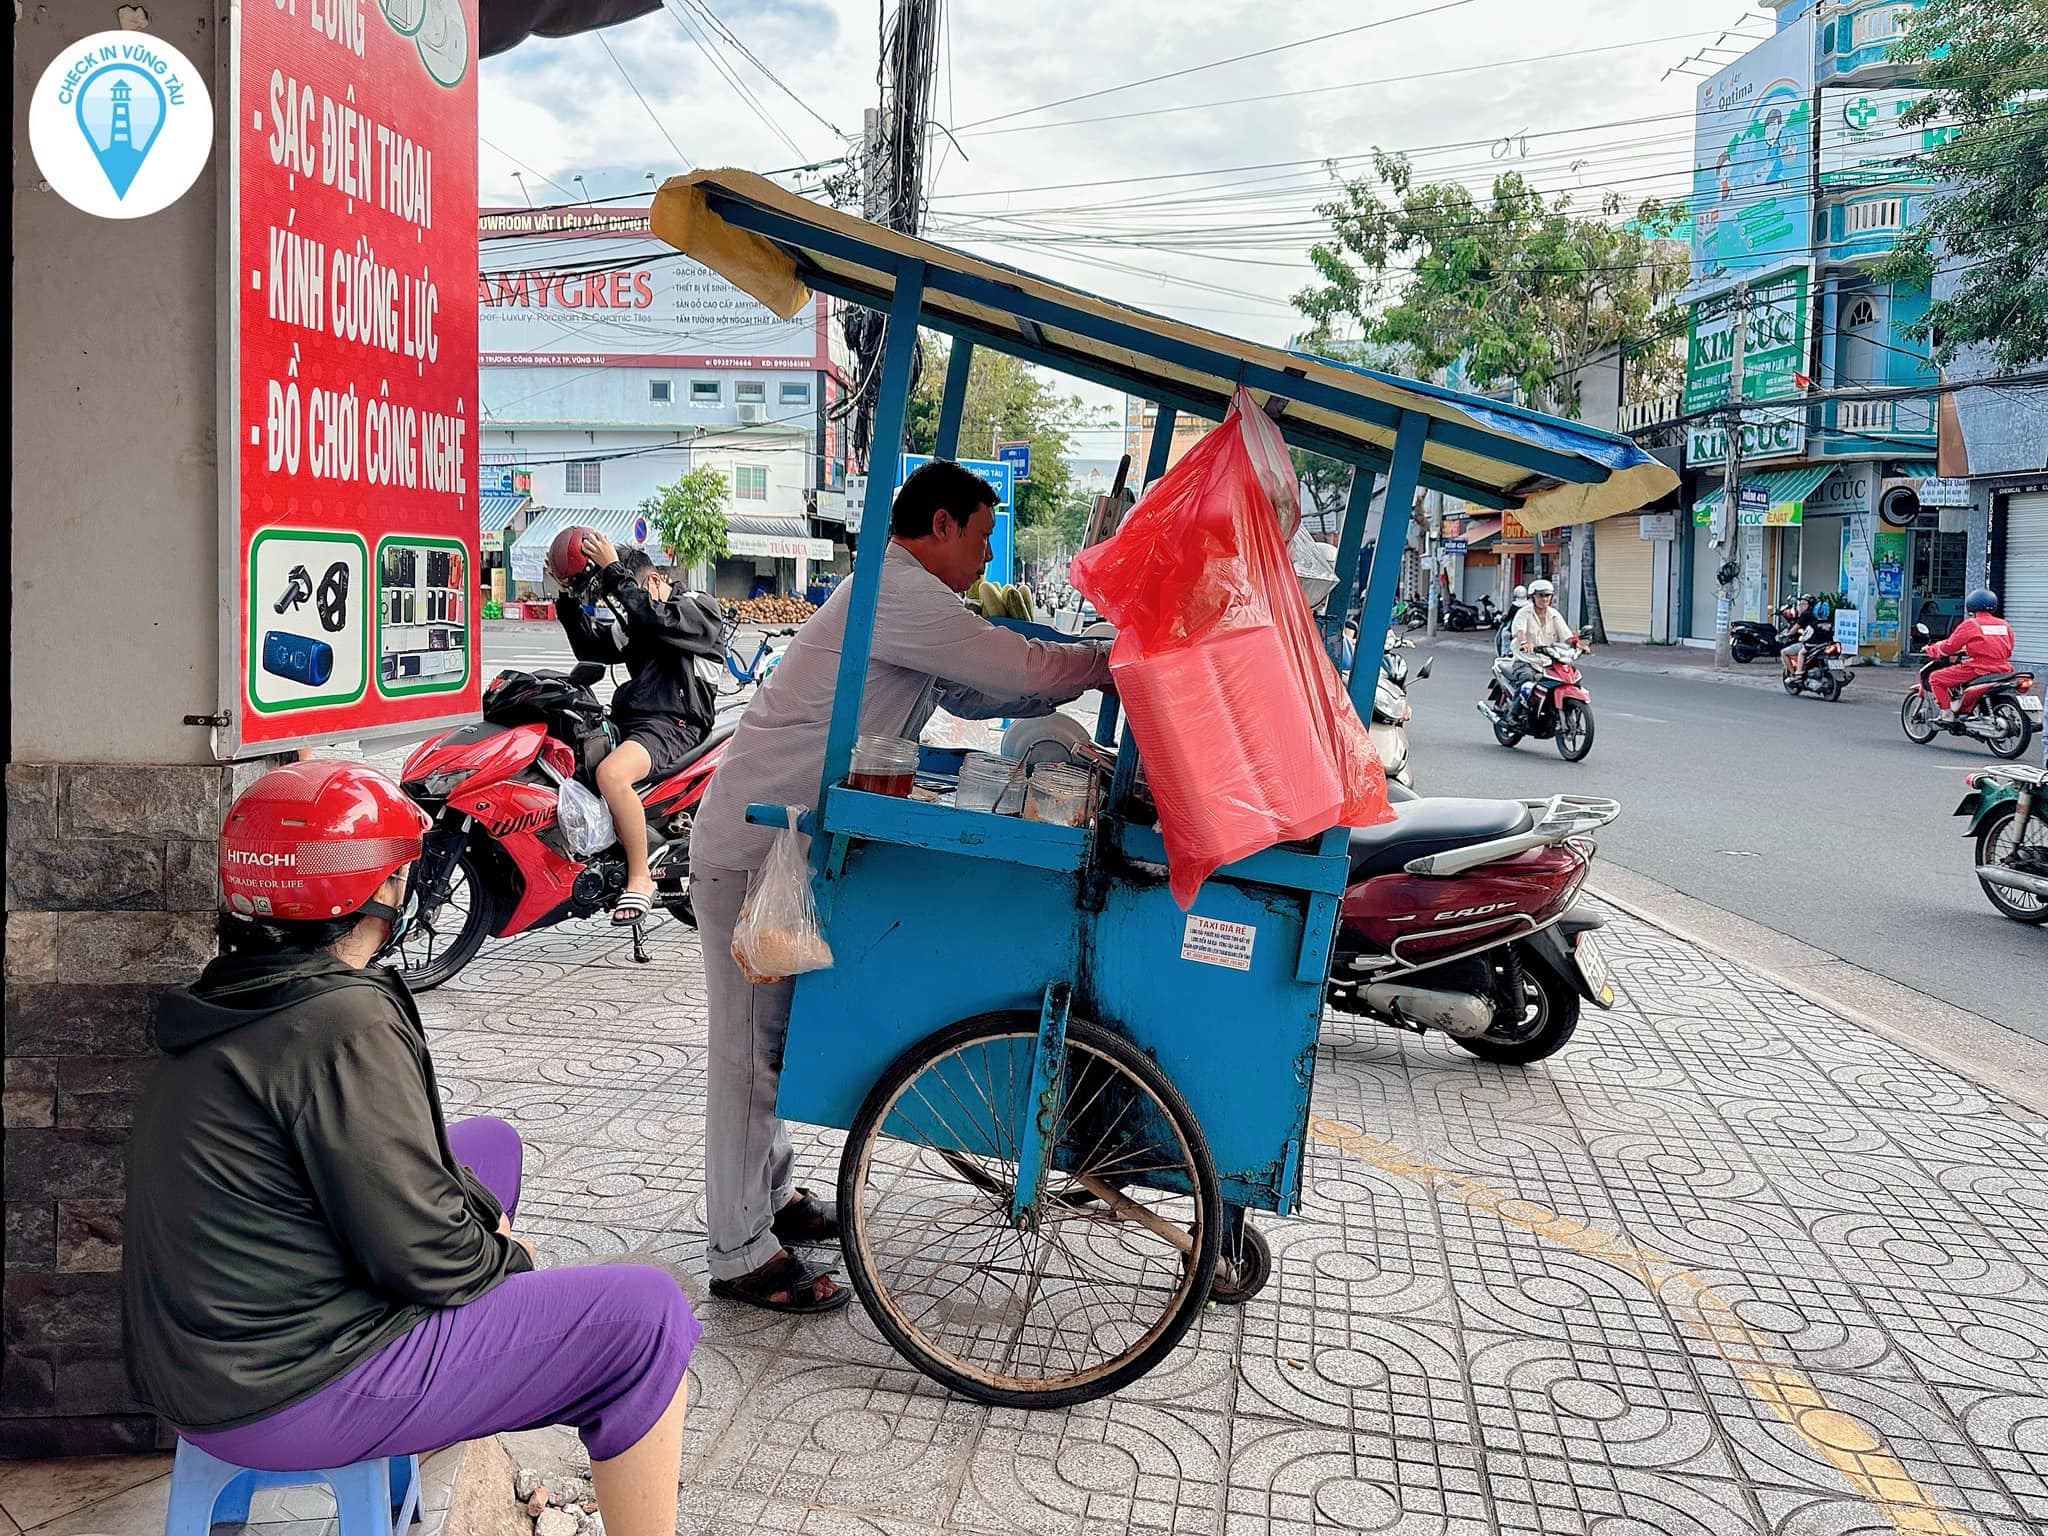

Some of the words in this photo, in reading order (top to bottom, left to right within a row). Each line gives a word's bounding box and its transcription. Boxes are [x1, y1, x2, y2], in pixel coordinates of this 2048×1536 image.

[1718, 83, 1753, 110] Optima
[269, 68, 316, 191] SẠC
[321, 84, 372, 214] ĐIỆN
[377, 123, 432, 243] THOẠI
[479, 215, 531, 231] OWROOM
[269, 208, 325, 332] KÍNH
[331, 234, 399, 354] CƯỜNG
[403, 265, 439, 377] LỰC
[478, 270, 653, 309] AMYGRES
[1695, 329, 1736, 367] KIM
[1744, 304, 1792, 353] CÚC
[266, 343, 300, 476] ĐỒ
[309, 380, 360, 481] CHƠI
[364, 380, 417, 490] CÔNG
[421, 397, 467, 511] NGHỆ
[1741, 413, 1791, 453] CÚC
[1829, 474, 1867, 501] CÚC
[494, 805, 558, 834] WINNE
[227, 848, 297, 868] HITACHI
[259, 880, 279, 888] FOR
[281, 880, 304, 888] LIFE
[1198, 919, 1218, 931] TAXI
